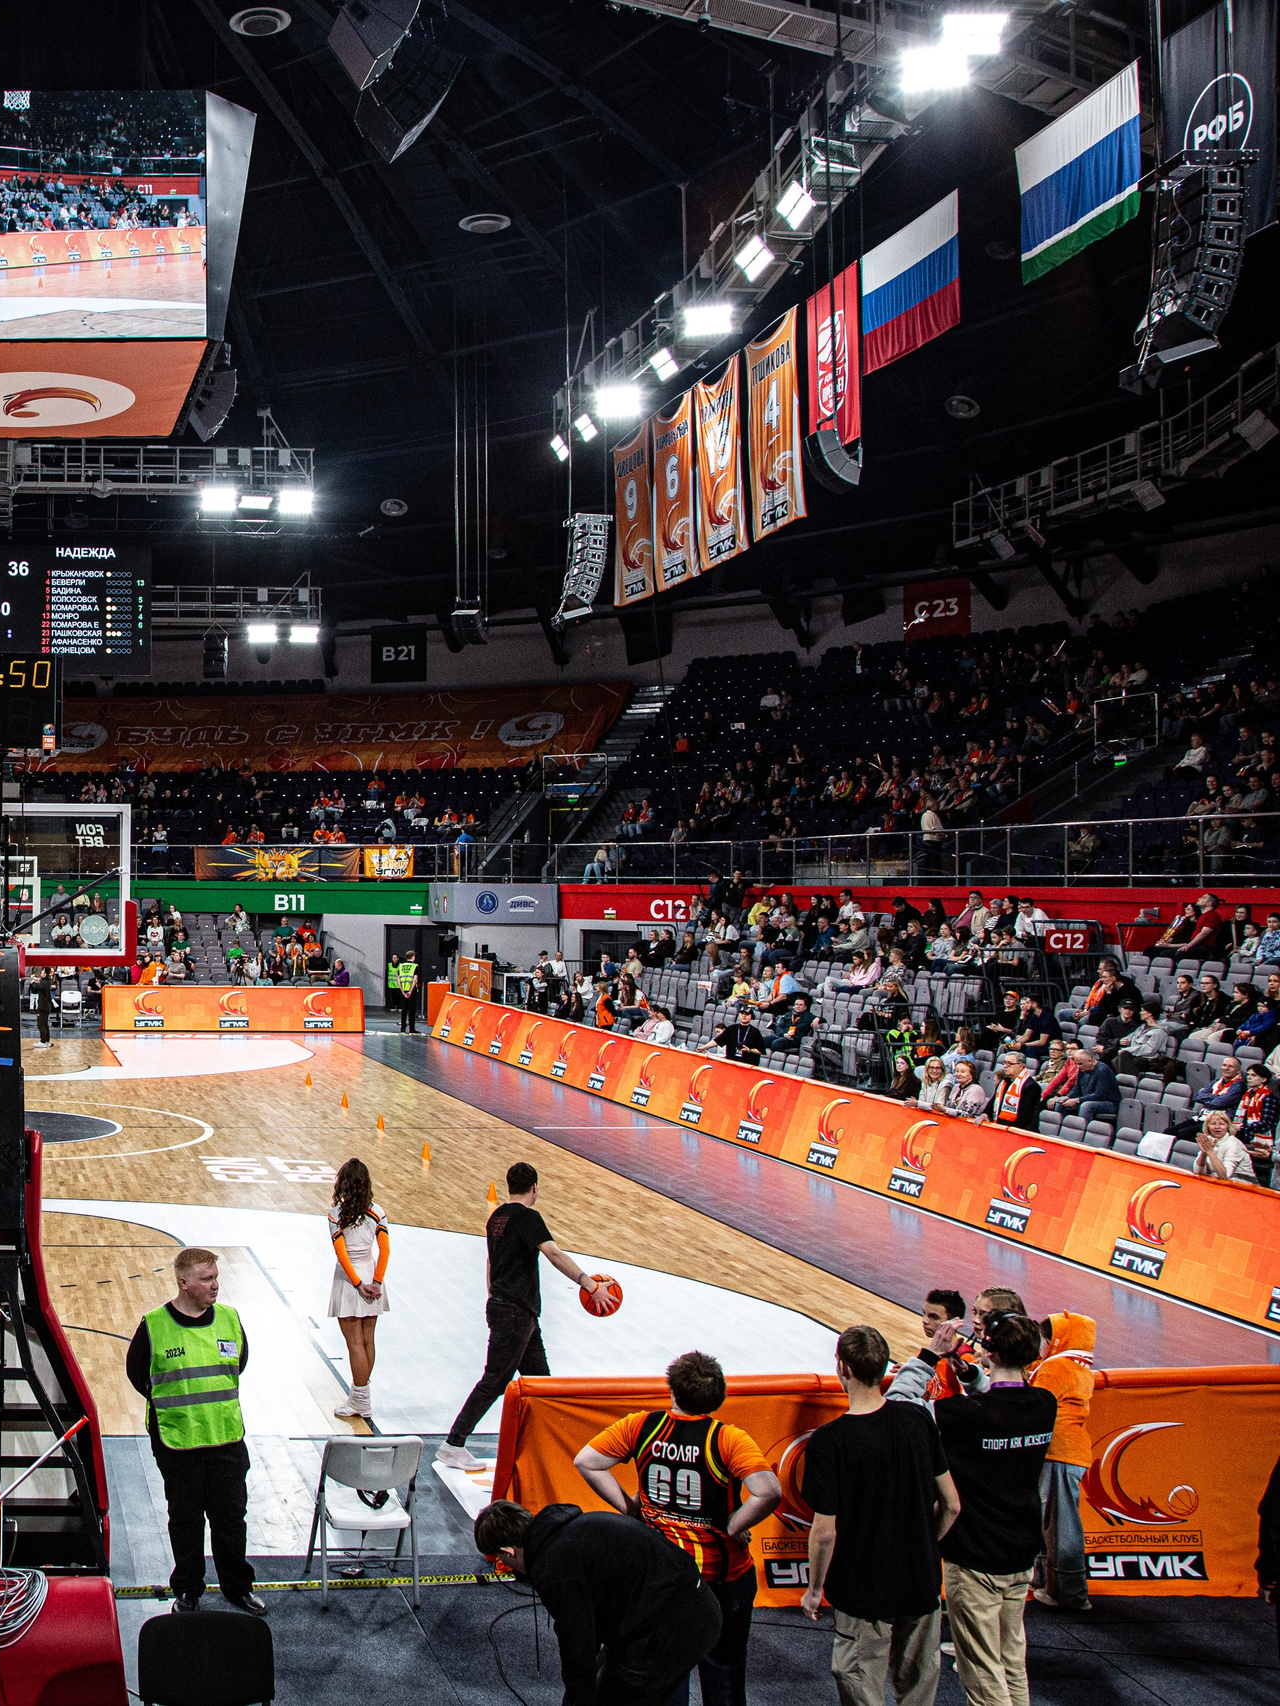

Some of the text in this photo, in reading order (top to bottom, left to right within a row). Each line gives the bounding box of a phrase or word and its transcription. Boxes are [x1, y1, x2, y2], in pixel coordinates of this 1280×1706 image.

[1193, 100, 1244, 150] РФБ
[138, 184, 153, 195] C11
[752, 339, 791, 388] ПШИКОВА
[764, 376, 781, 431] 4
[665, 453, 680, 500] 6
[624, 477, 638, 521] 9
[56, 547, 116, 558] НАДЕЖДА
[8, 562, 30, 577] 36
[51, 647, 96, 655] КУЗНЕЦОВА
[114, 726, 249, 748] БУДЬ
[314, 720, 461, 743] УГМК
[274, 894, 305, 911] B11
[650, 900, 686, 919] C12
[1049, 934, 1085, 949] C12
[680, 1109, 700, 1123] УГМК
[737, 1127, 760, 1143] УГМК
[807, 1151, 835, 1168] УГМК
[889, 1178, 922, 1196] УГМК
[987, 1210, 1026, 1231] УГМК
[1112, 1251, 1161, 1277] УГМК
[165, 1346, 186, 1359] 20234
[982, 1432, 1053, 1450] СПОРТ КАК ИСКУССТВ
[652, 1440, 700, 1463] СТОЛЯР
[648, 1463, 702, 1511] 69
[1084, 1534, 1200, 1546] БАСКЕТБОЛЬНЫЙ КЛУБ
[772, 1562, 811, 1584] УГ
[1088, 1555, 1203, 1578] УГМК
